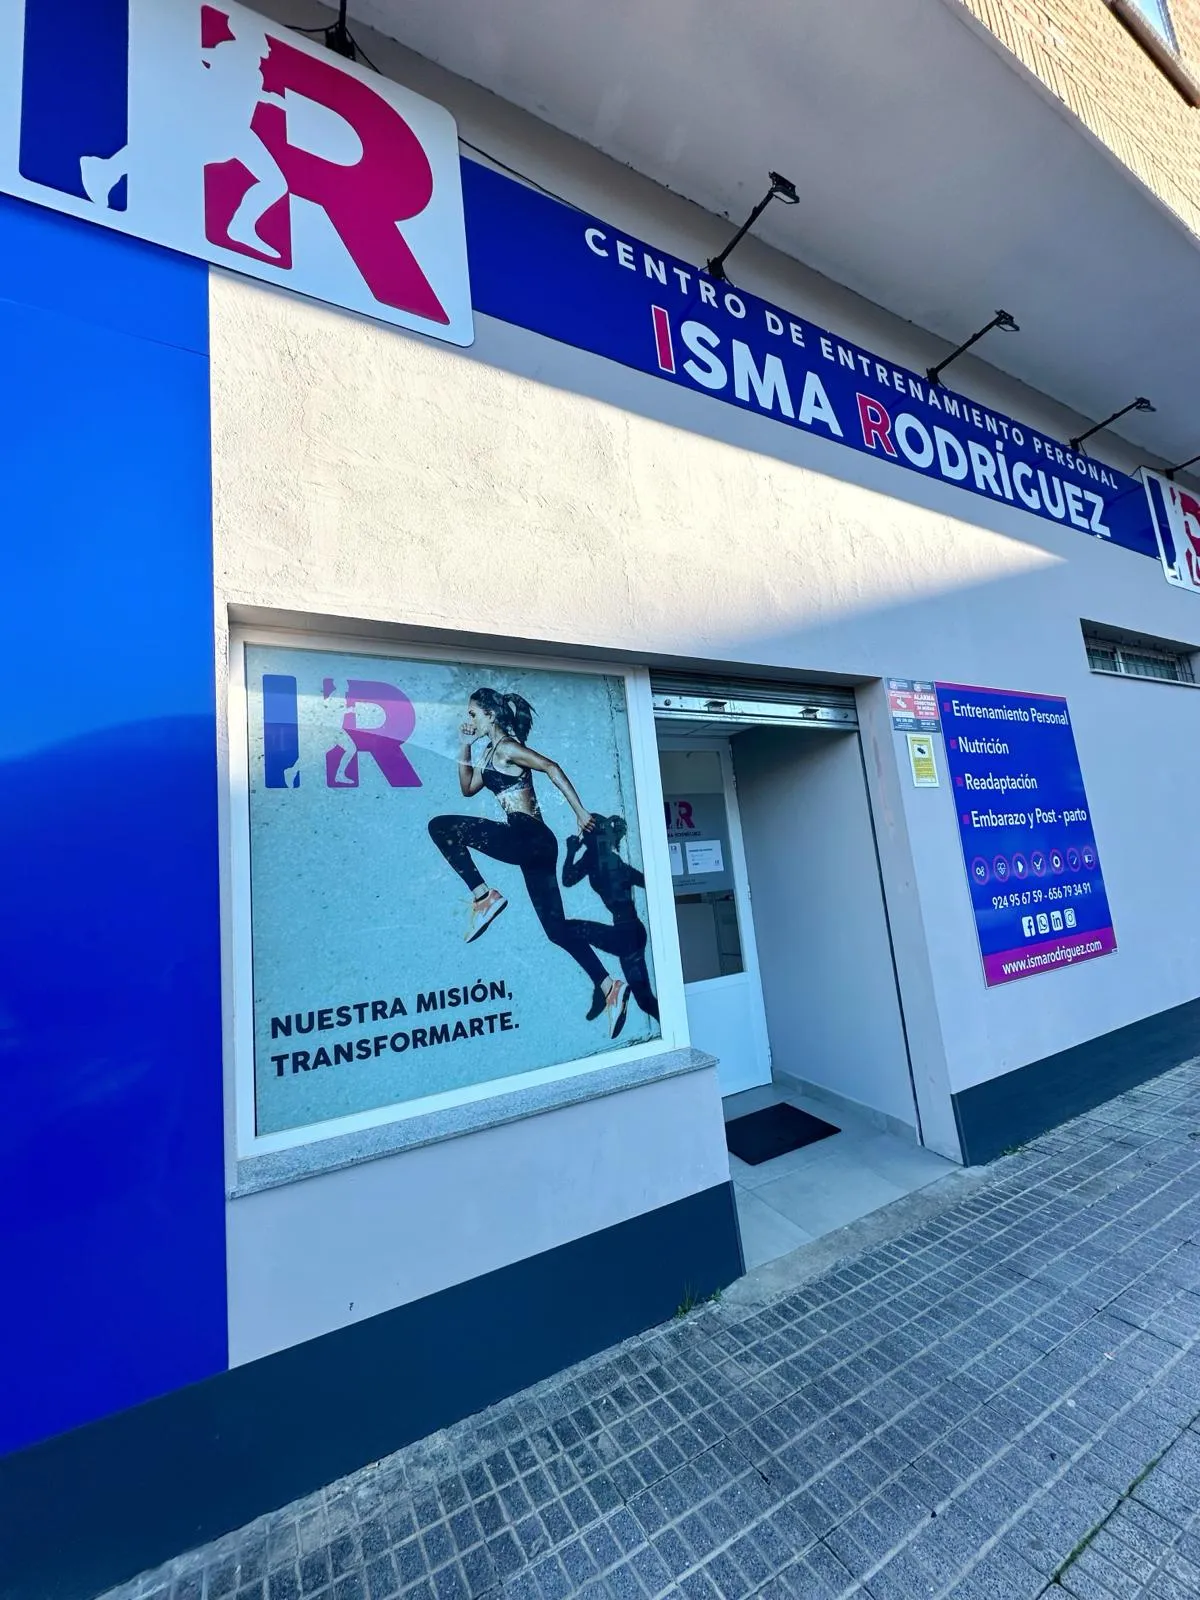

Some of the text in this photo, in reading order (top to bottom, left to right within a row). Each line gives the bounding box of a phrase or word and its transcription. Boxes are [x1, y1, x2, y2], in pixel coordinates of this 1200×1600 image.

[584, 228, 1118, 490] CENTRO DE ENTRENAMIENTO PERSONAL
[651, 304, 1111, 537] ISMA RODRÍGUEZ
[952, 700, 1069, 726] Entrenamiento Personal
[958, 736, 1009, 754] Nutrición
[964, 772, 1038, 794] Readaptación
[971, 809, 1026, 828] Embarazo
[1027, 816, 1034, 829] y
[1035, 807, 1057, 824] Post
[1063, 808, 1087, 826] parto
[992, 895, 1009, 909] 924
[1009, 893, 1020, 907] 95
[1021, 891, 1031, 904] 67
[1032, 889, 1043, 902] 59
[1048, 887, 1063, 900] 656
[1063, 885, 1072, 897] 79
[1073, 883, 1083, 896] 34
[1082, 882, 1092, 894] 91
[1002, 940, 1102, 975] www.ismarodriguez.com
[271, 978, 513, 1039] NUESTRA MISIÓN,
[271, 1011, 520, 1077] TRANSFORMARTE.
